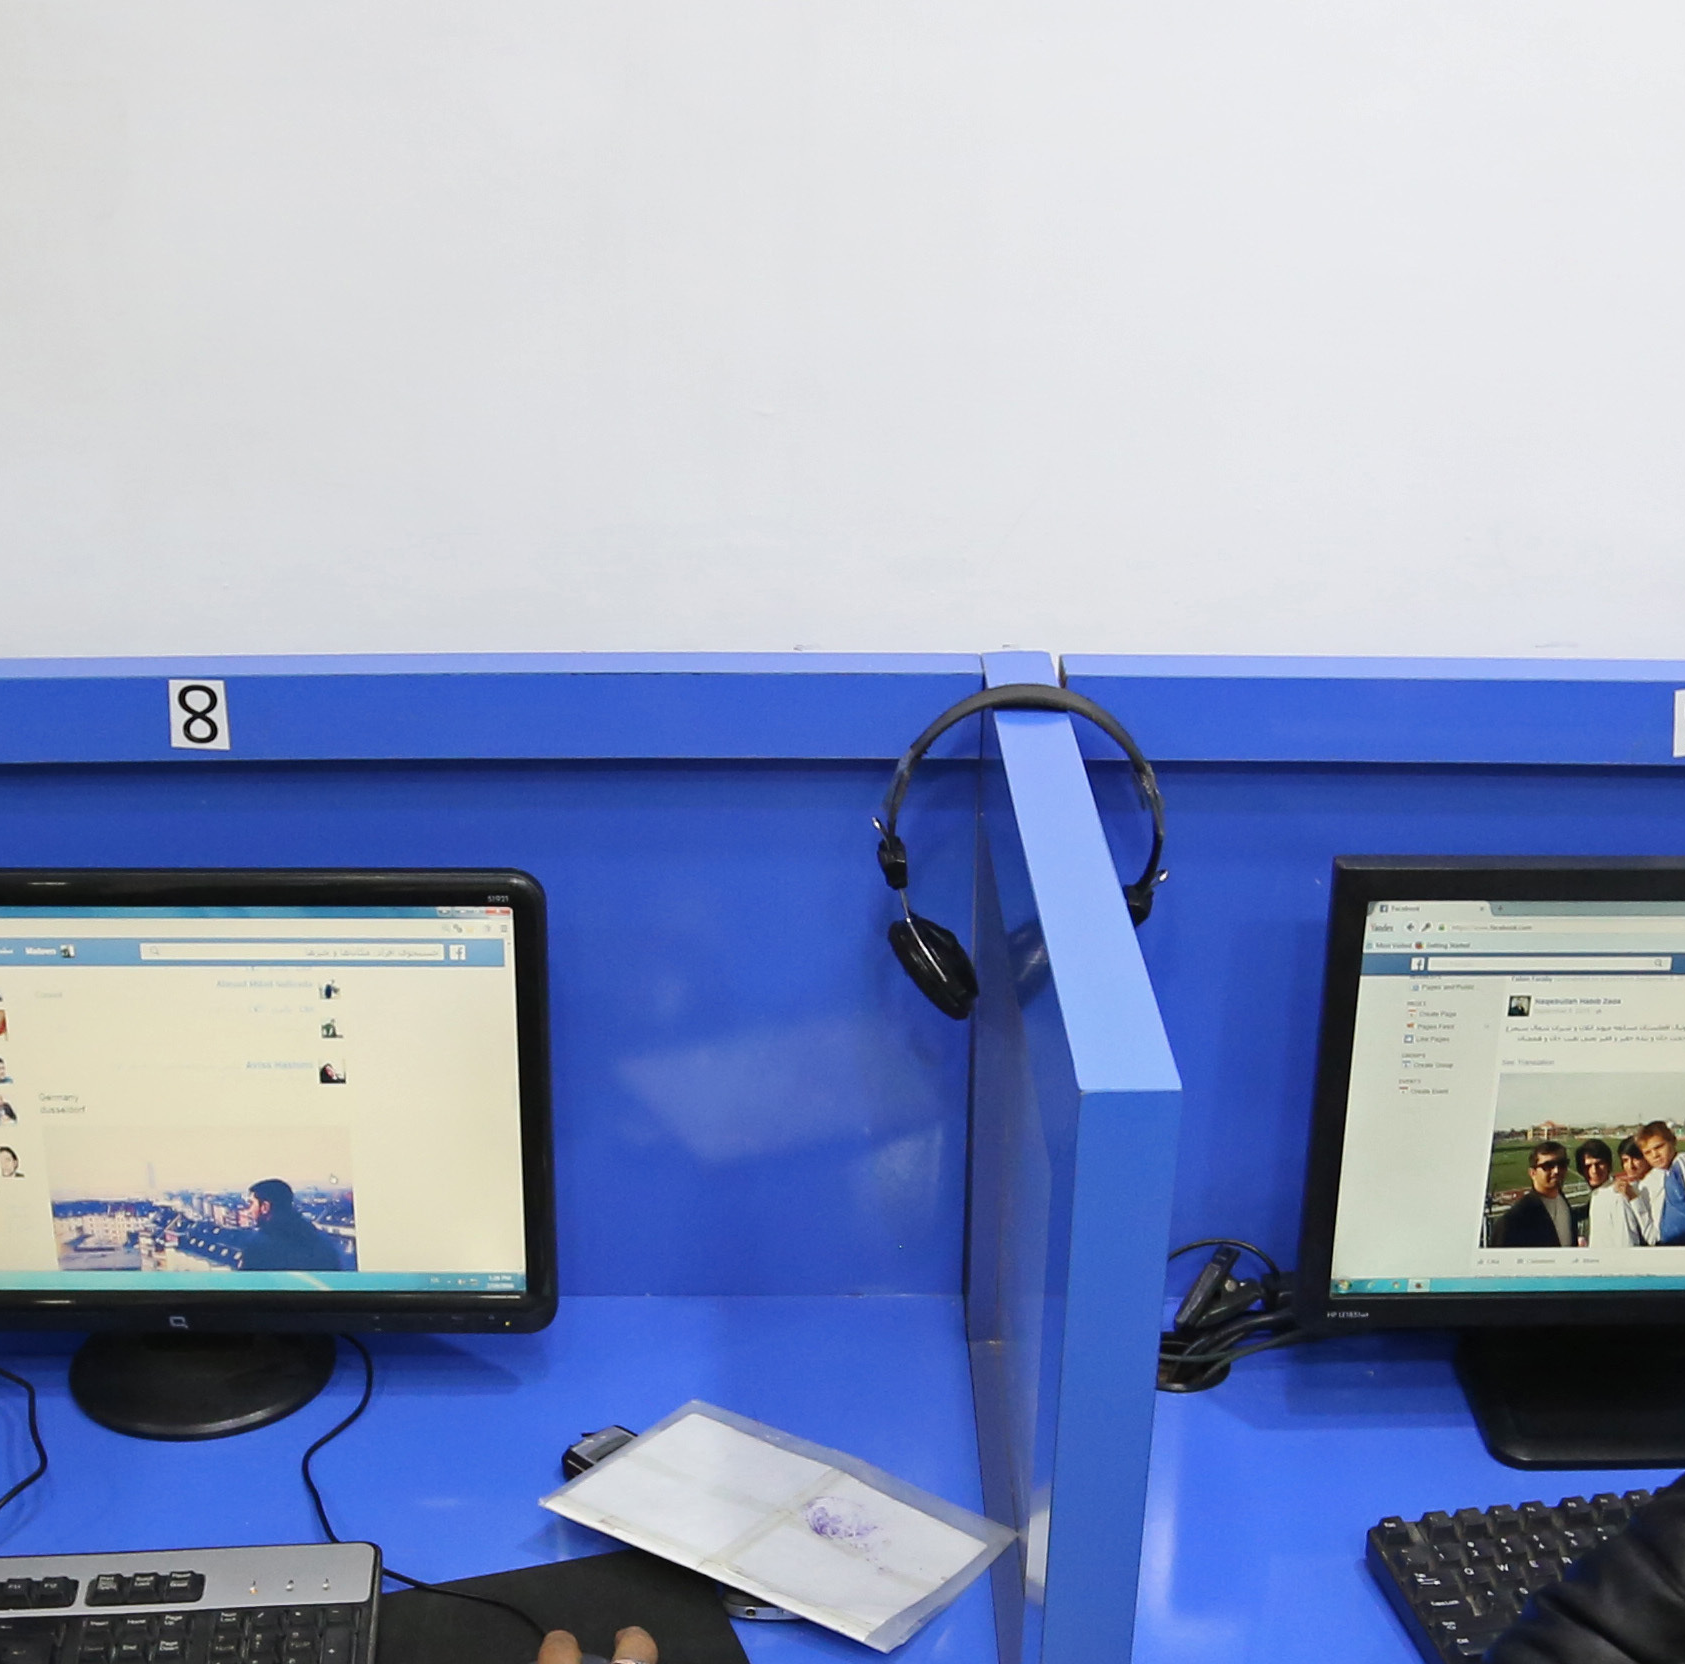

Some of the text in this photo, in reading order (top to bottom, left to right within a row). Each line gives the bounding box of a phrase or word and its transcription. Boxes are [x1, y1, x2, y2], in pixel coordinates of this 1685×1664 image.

[178, 684, 218, 744] 8
[39, 1093, 79, 1103] Germany
[1496, 1563, 1509, 1572] W
